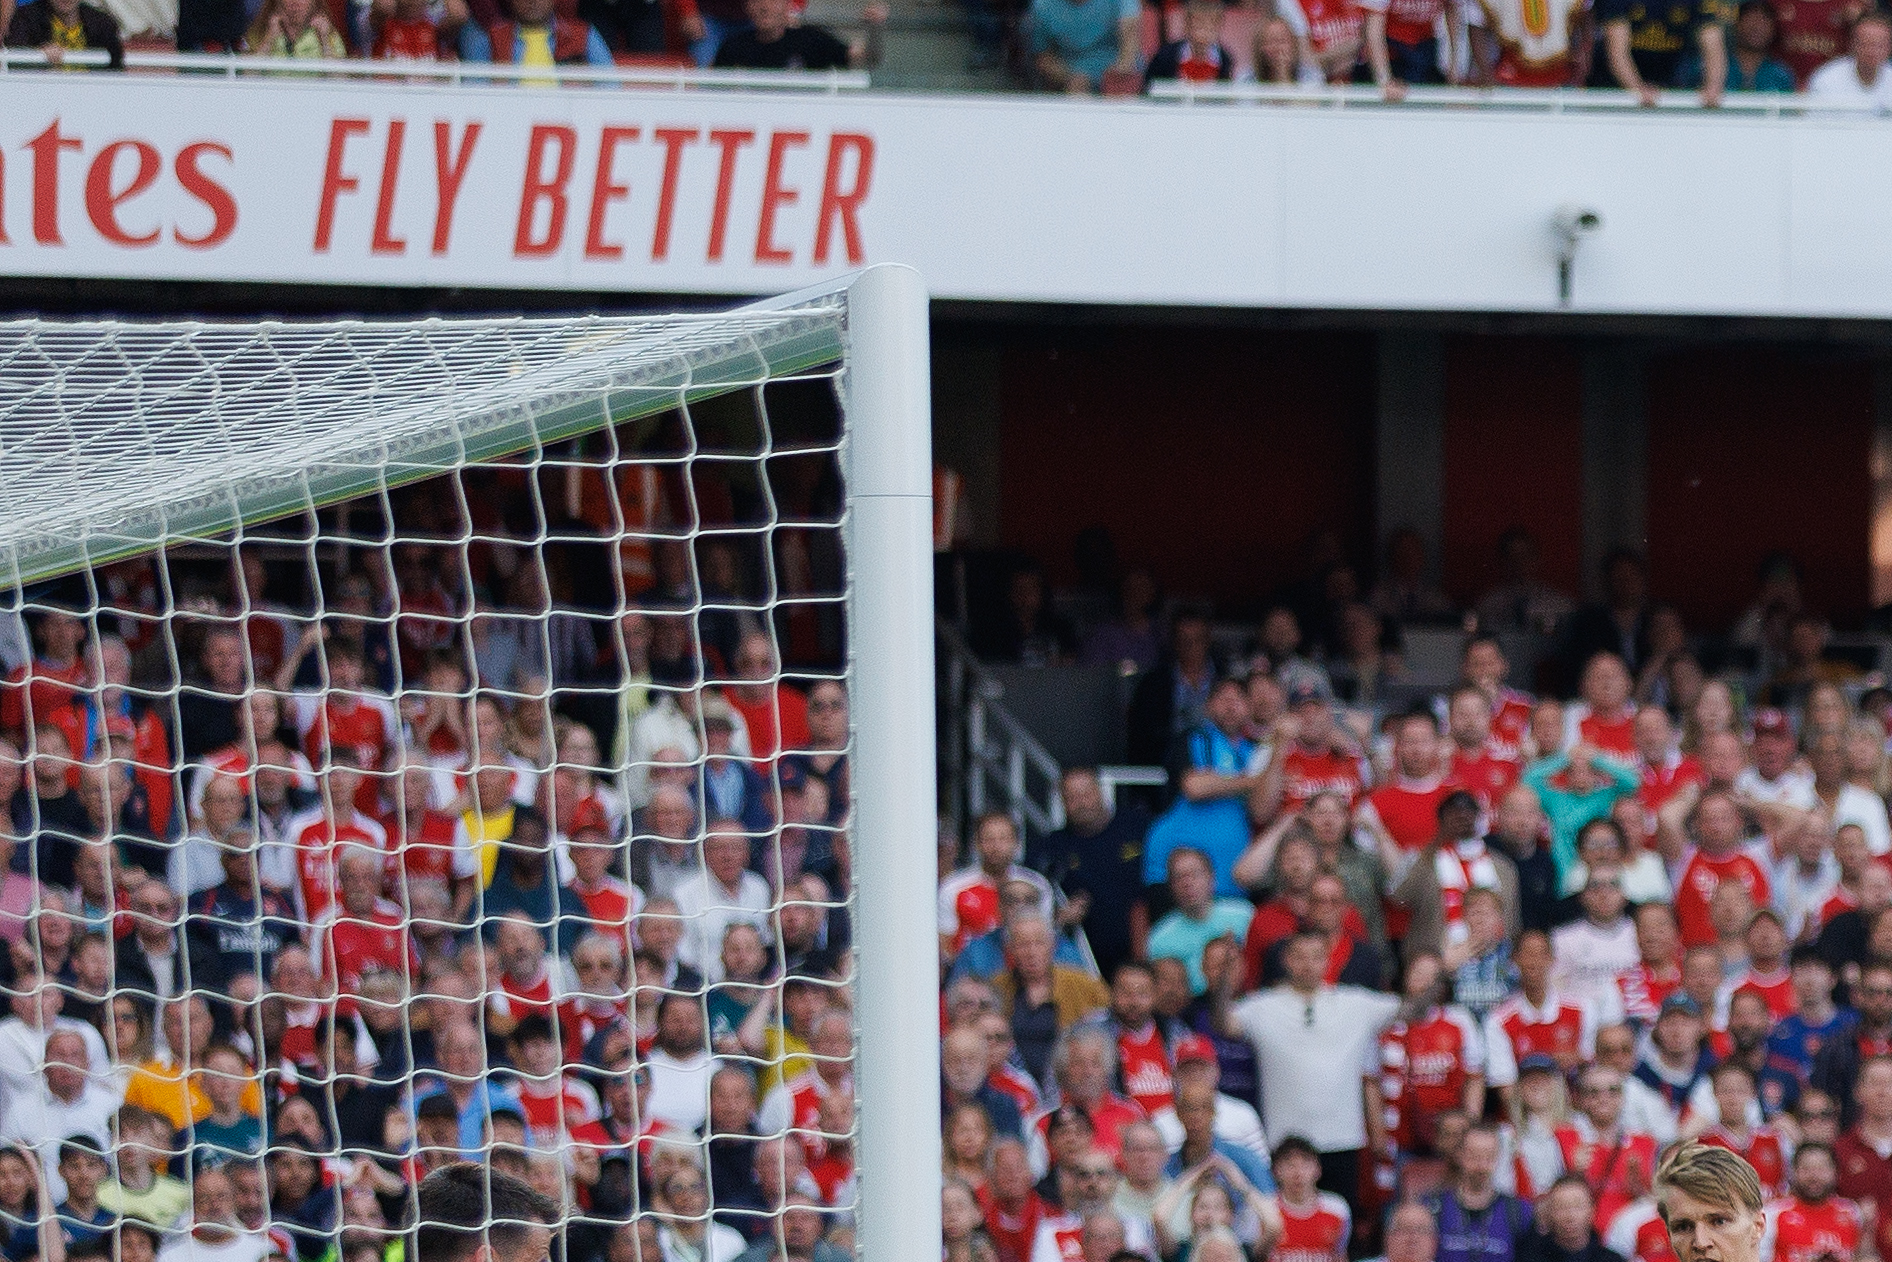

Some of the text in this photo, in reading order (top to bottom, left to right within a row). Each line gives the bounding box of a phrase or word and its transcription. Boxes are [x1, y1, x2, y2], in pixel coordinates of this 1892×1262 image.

[0, 118, 876, 265] tes FLY BETTER
